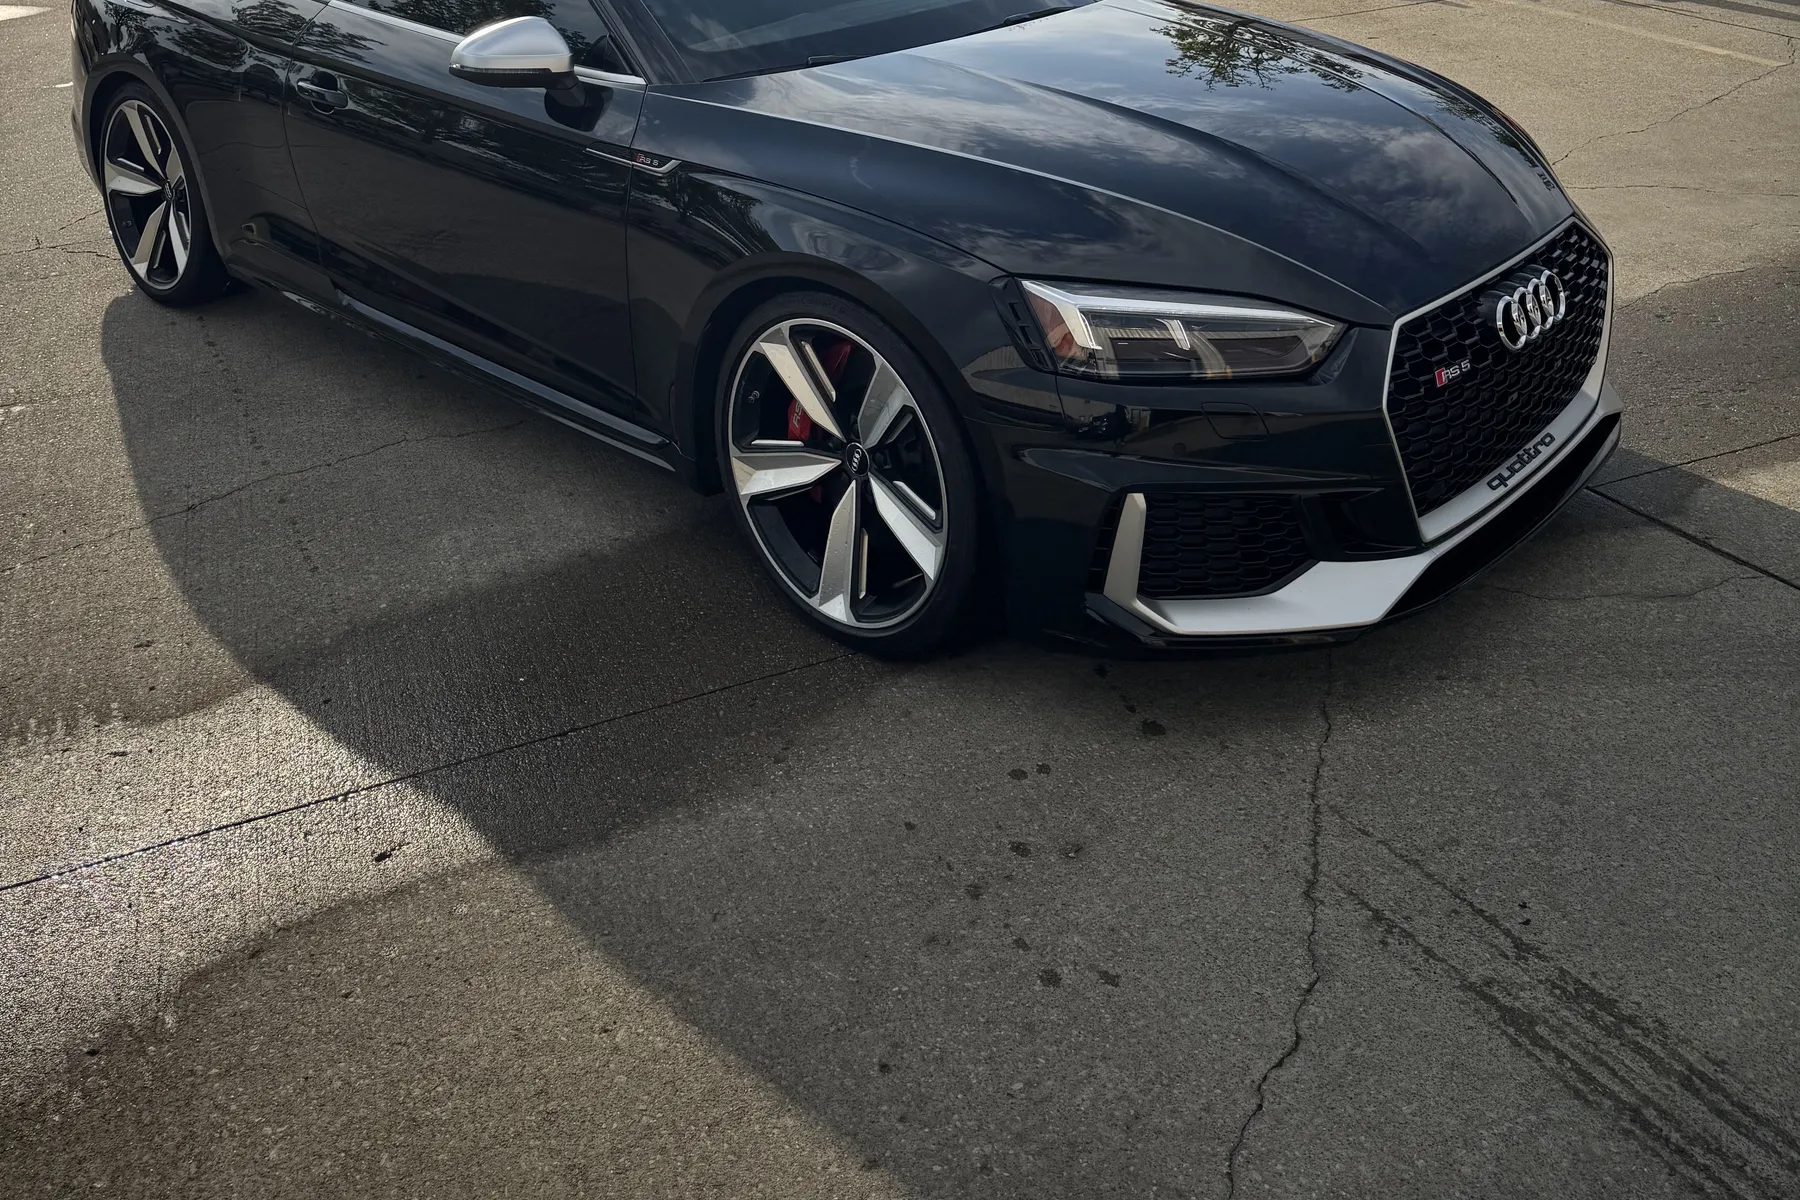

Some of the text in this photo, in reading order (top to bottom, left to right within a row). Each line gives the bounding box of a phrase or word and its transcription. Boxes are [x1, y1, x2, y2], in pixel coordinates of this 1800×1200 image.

[1435, 359, 1470, 387] RS 5
[1486, 432, 1556, 491] quattro
